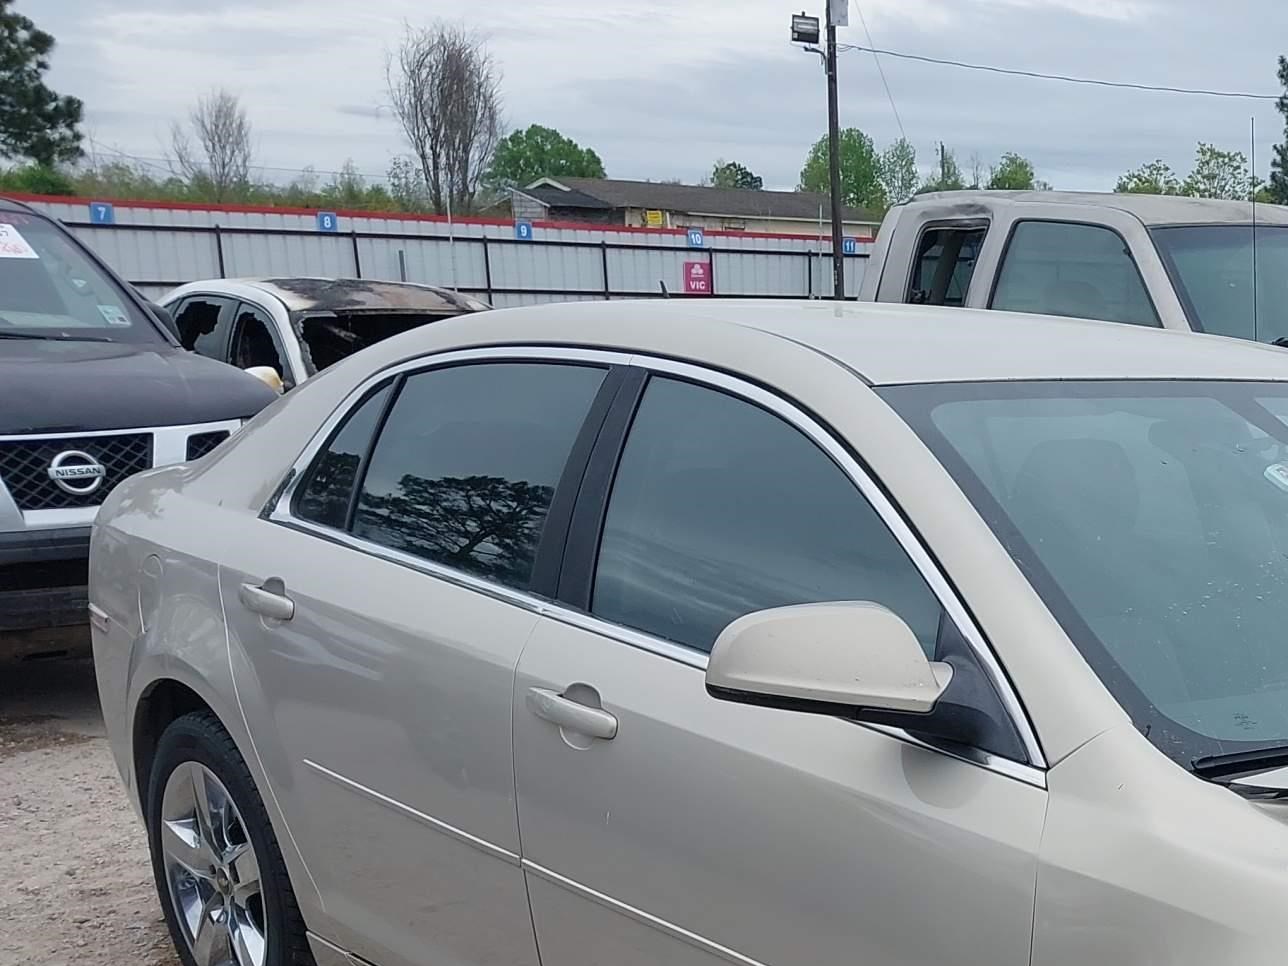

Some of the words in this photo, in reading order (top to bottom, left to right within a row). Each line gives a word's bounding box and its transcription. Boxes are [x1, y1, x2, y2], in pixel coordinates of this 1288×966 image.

[97, 206, 106, 221] 7
[323, 215, 332, 229] 8
[520, 224, 528, 237] 9
[691, 233, 702, 245] 10
[845, 240, 854, 252] 11
[689, 280, 706, 290] VIC
[55, 467, 101, 477] NISSAN
